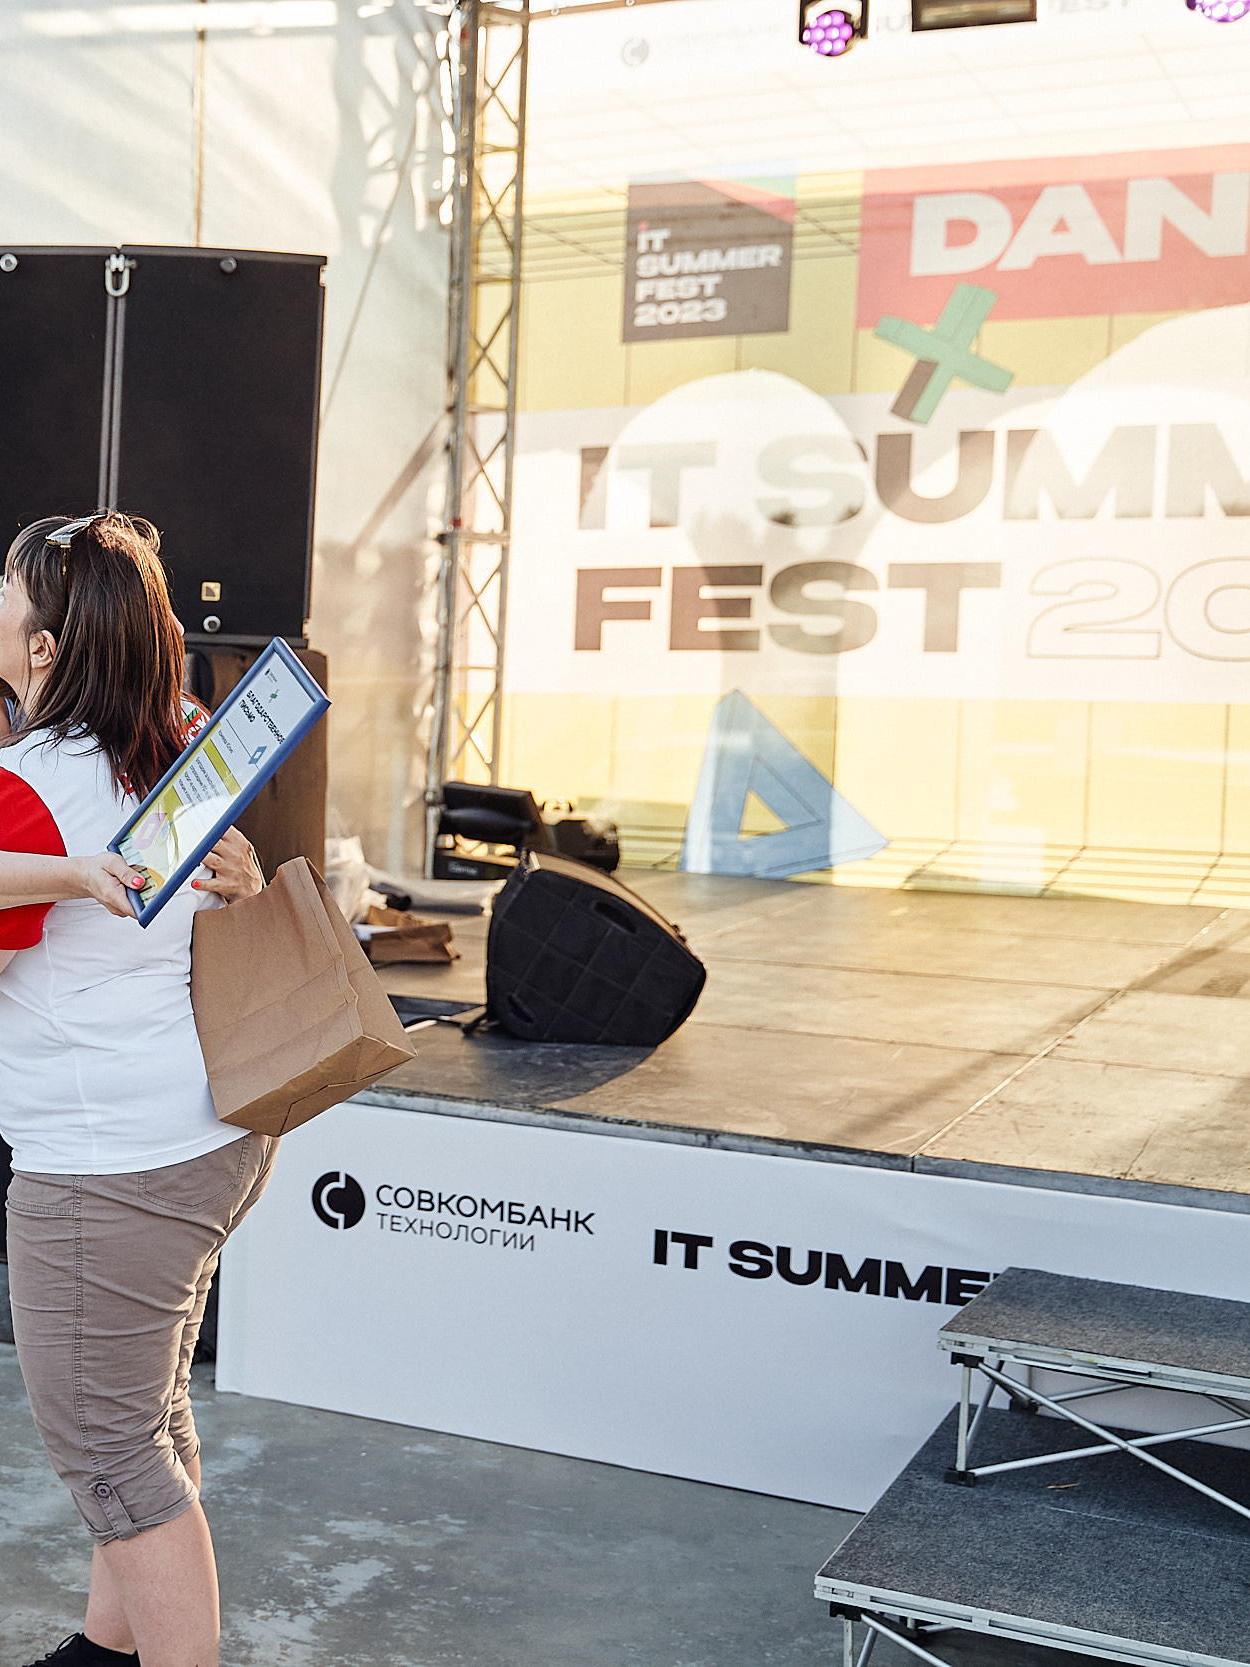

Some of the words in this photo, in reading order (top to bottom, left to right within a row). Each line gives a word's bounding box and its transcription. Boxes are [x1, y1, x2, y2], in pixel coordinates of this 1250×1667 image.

[910, 171, 1250, 277] DAN
[636, 244, 783, 278] SUMMER
[633, 298, 727, 327] 2023
[635, 273, 722, 302] FEST
[579, 441, 717, 530] IT
[574, 559, 1001, 654] FEST
[376, 1184, 595, 1235] СОВКОМБАНК
[376, 1212, 535, 1251] ТЕХНОЛОГИИ
[653, 1229, 713, 1269] IT
[728, 1239, 1001, 1307] SUMME
